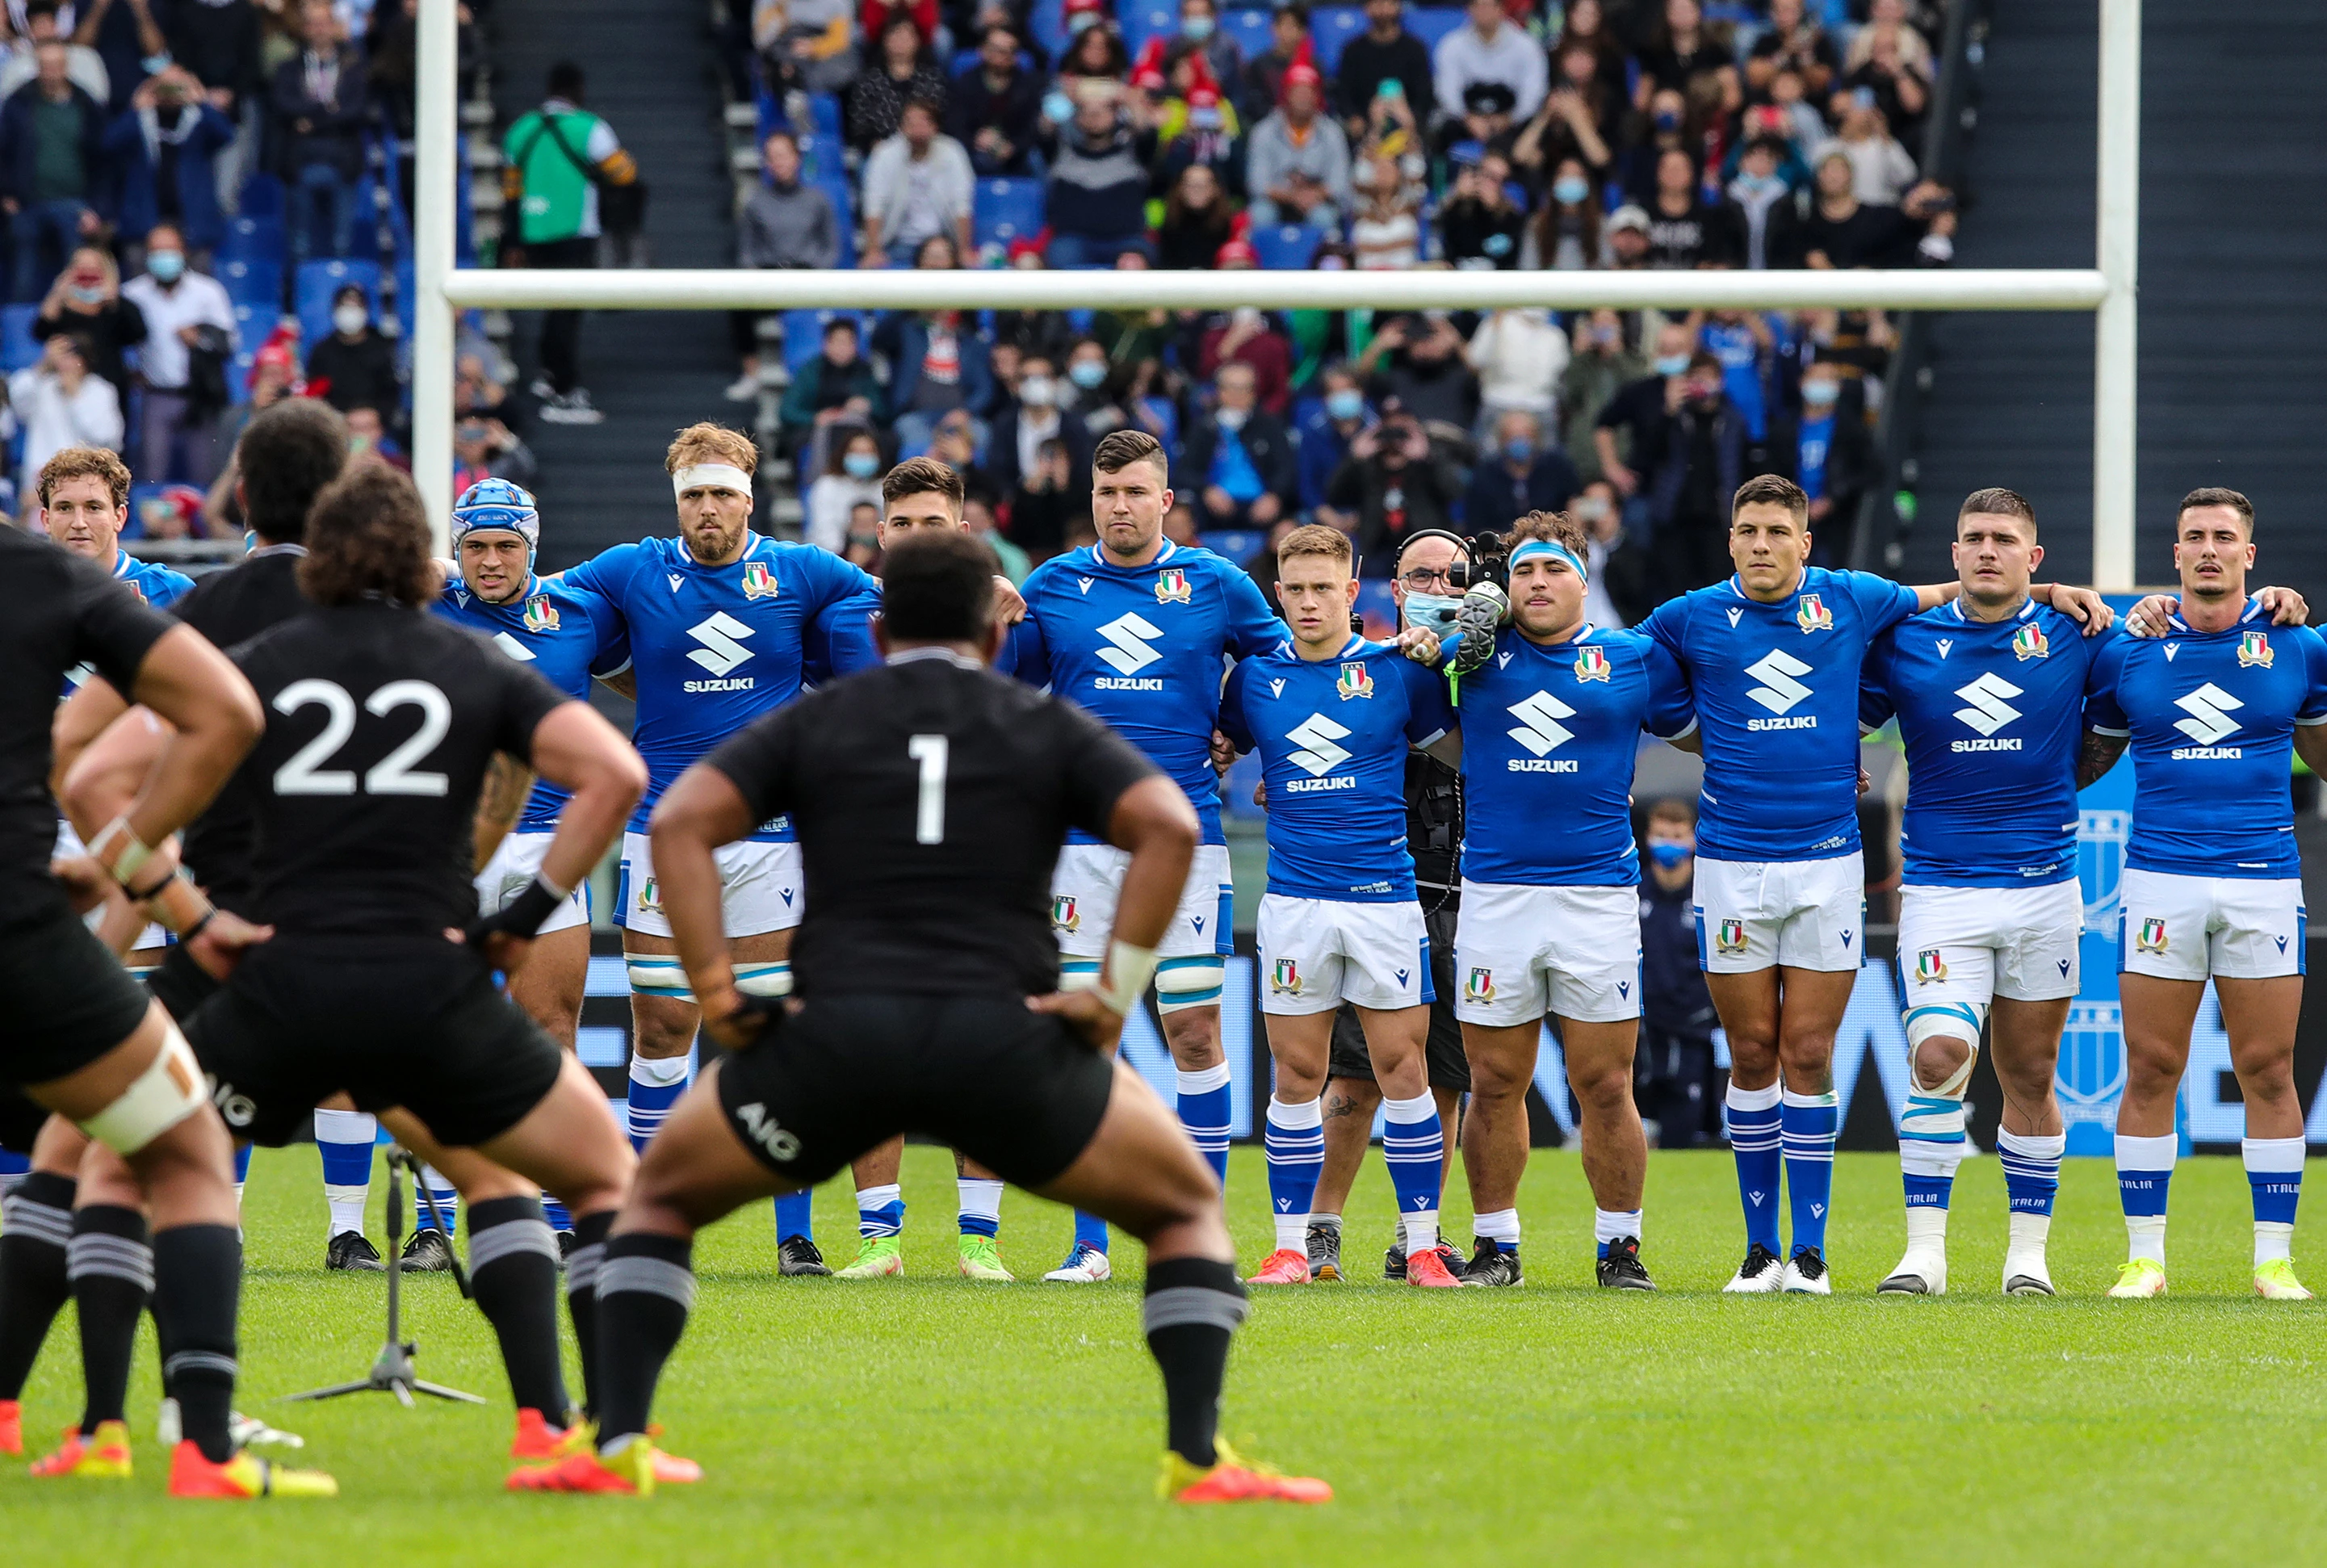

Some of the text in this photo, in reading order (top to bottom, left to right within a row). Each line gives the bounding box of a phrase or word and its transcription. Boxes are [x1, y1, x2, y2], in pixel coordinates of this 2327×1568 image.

[683, 677, 754, 693] SUZUKI
[1094, 677, 1163, 691] SUZUKI
[1747, 716, 1817, 732] SUZUKI
[272, 678, 452, 797] 22
[1951, 738, 2022, 753] SUZUKI
[2171, 748, 2241, 760] SUZUKI
[1507, 759, 1578, 774] SUZUKI
[908, 734, 949, 845] 1
[1286, 776, 1356, 793] SUZUKI
[736, 1102, 802, 1161] AIG
[1906, 1193, 1938, 1204] ITALIA
[2011, 1198, 2046, 1207] ITALIA
